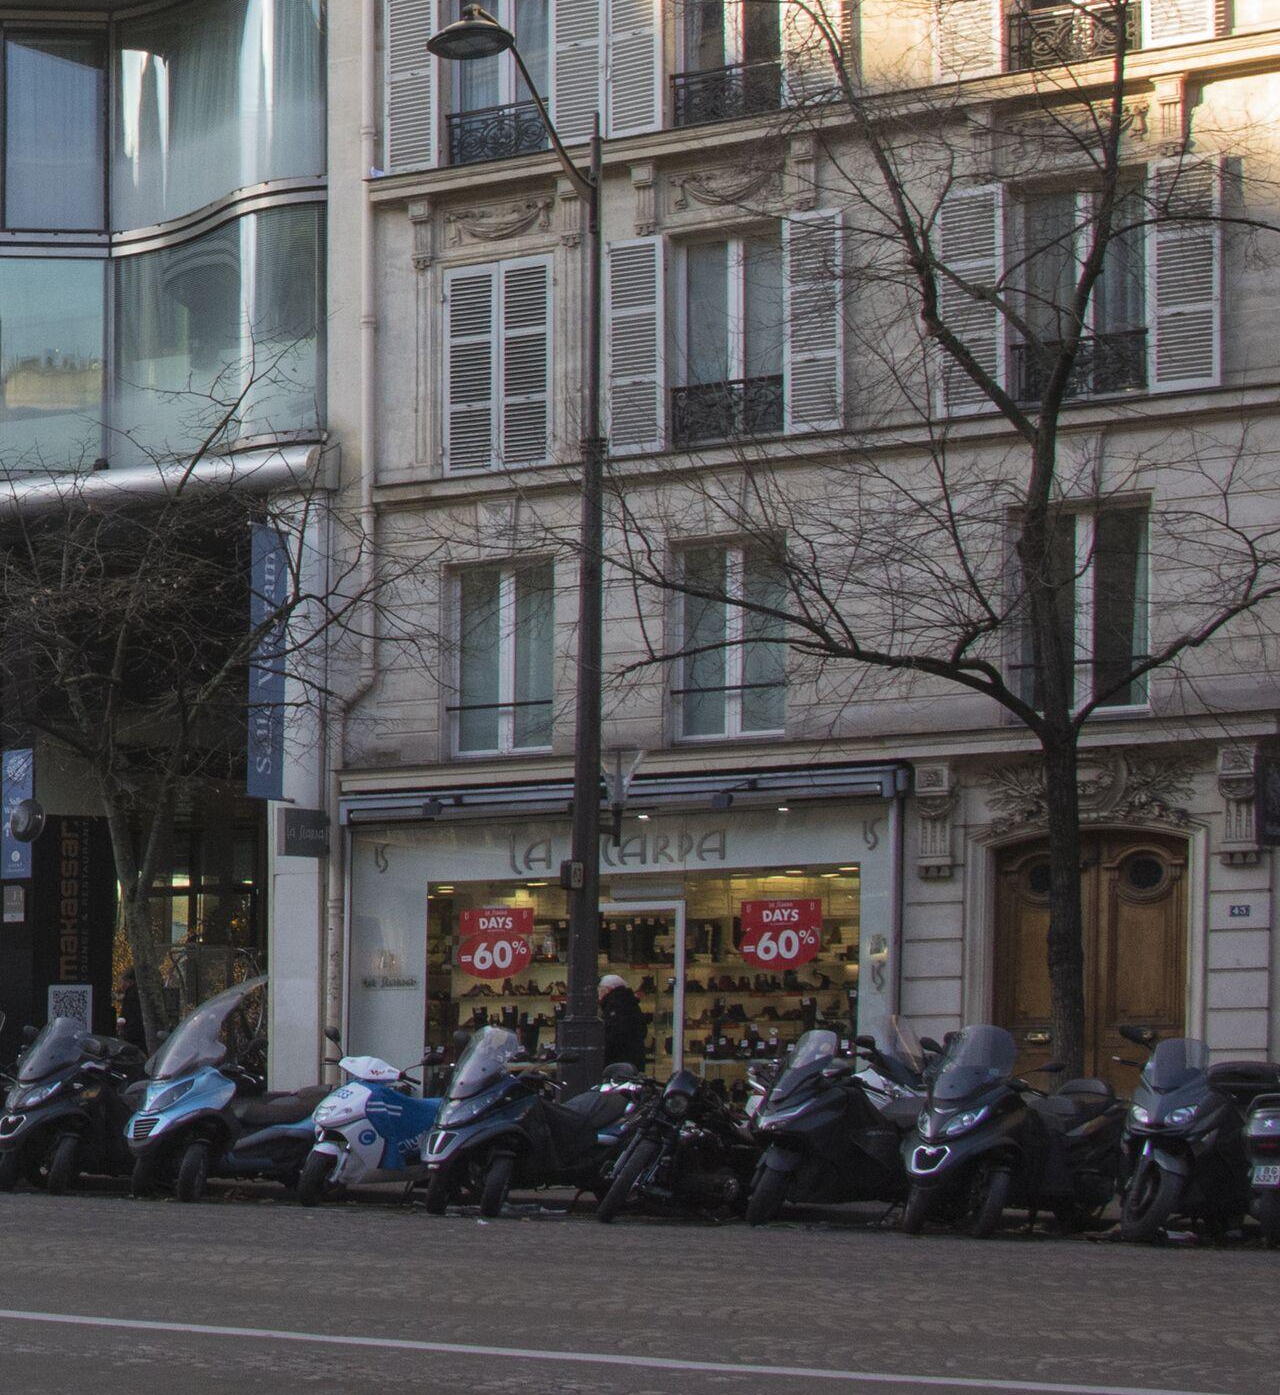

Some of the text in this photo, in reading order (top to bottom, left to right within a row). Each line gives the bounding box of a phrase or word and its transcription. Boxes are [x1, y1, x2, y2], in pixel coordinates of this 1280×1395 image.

[258, 551, 277, 687] Waram
[509, 833, 553, 875] LA
[479, 916, 513, 930] DAYS
[762, 908, 800, 923] DAYS
